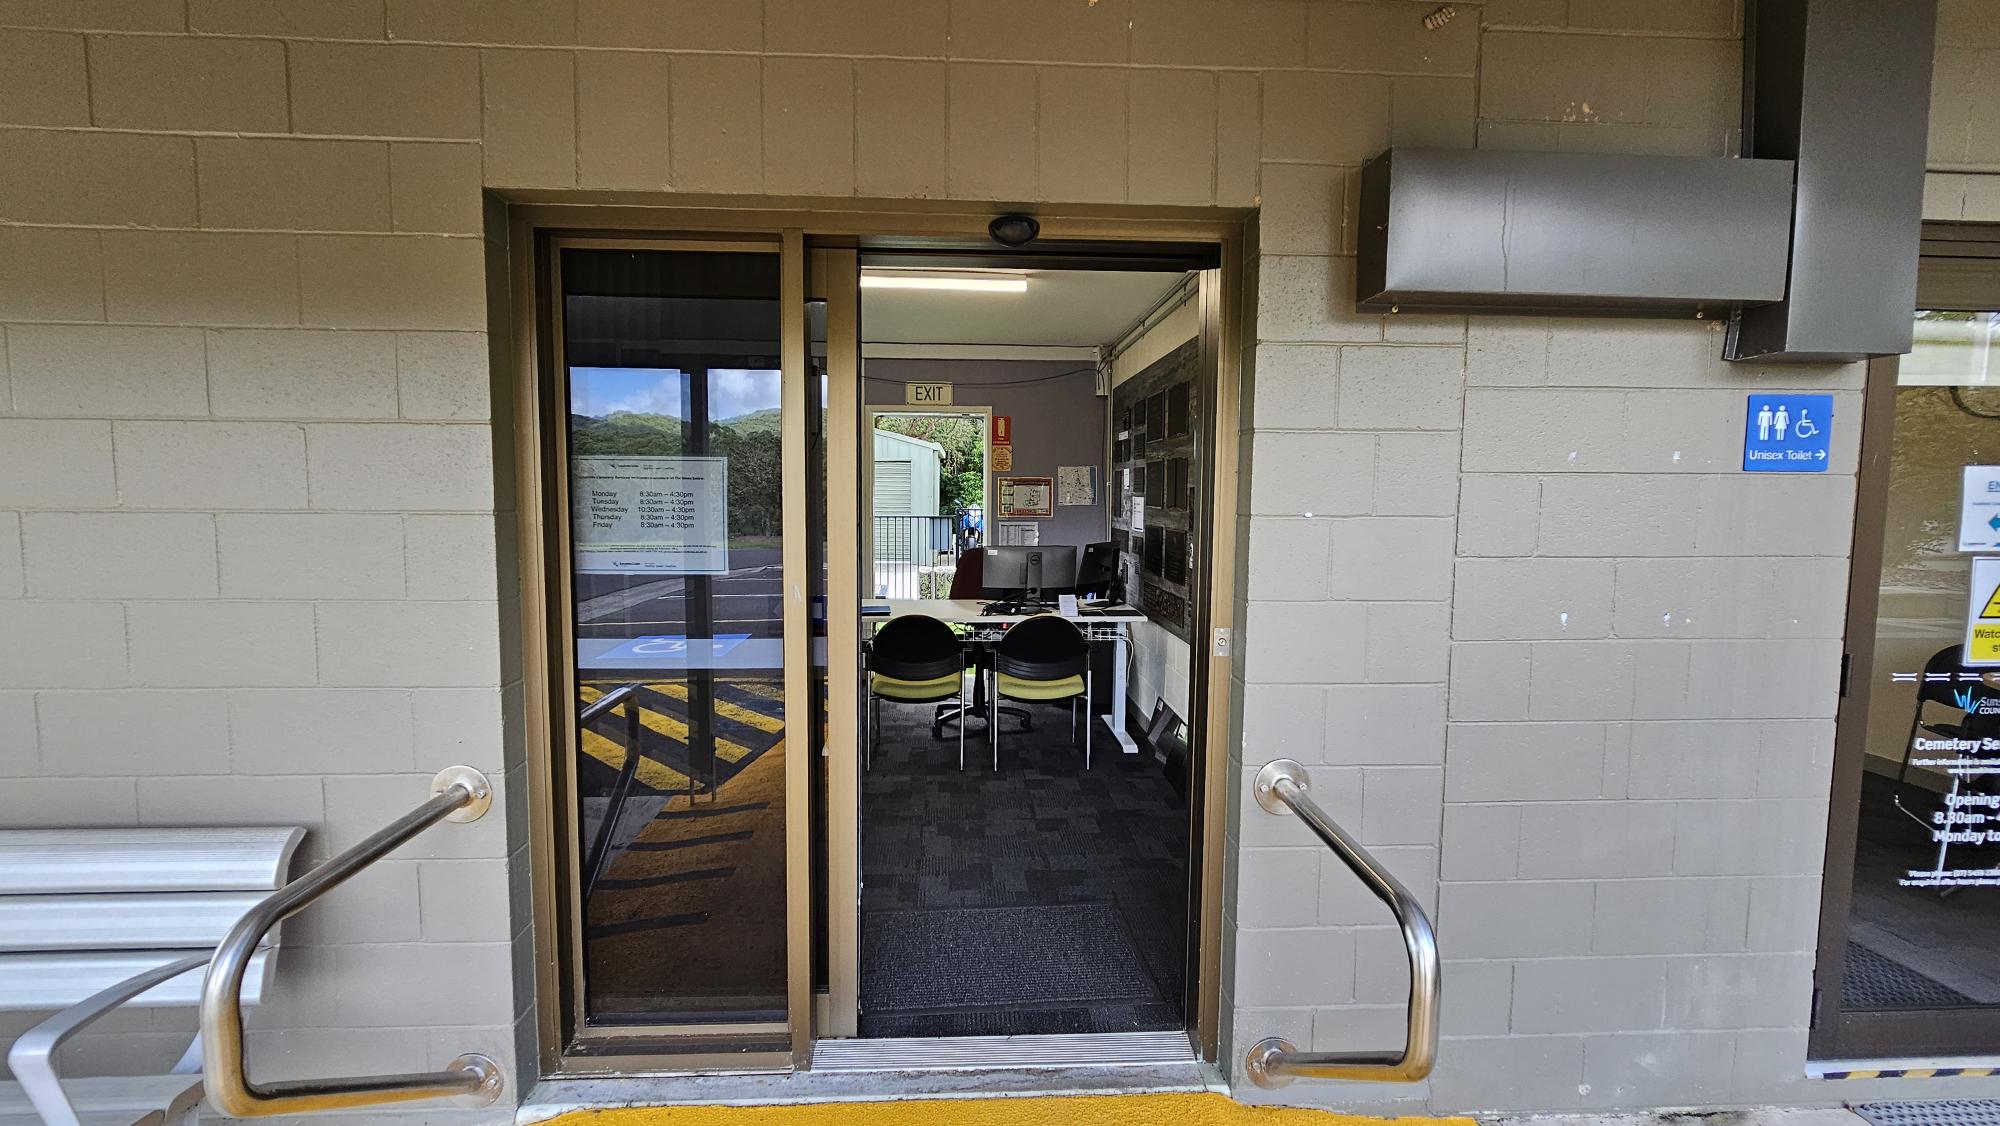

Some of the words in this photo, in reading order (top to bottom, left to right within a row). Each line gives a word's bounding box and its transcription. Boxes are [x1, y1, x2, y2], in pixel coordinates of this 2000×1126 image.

[915, 386, 943, 401] EXIT
[1749, 450, 1783, 460] Unisex
[1786, 450, 1812, 460] Toilet
[1915, 737, 1981, 754] Cemetery
[1945, 793, 2000, 809] Opening
[1933, 811, 1985, 825] 8.30am
[1932, 829, 1986, 845] Monday
